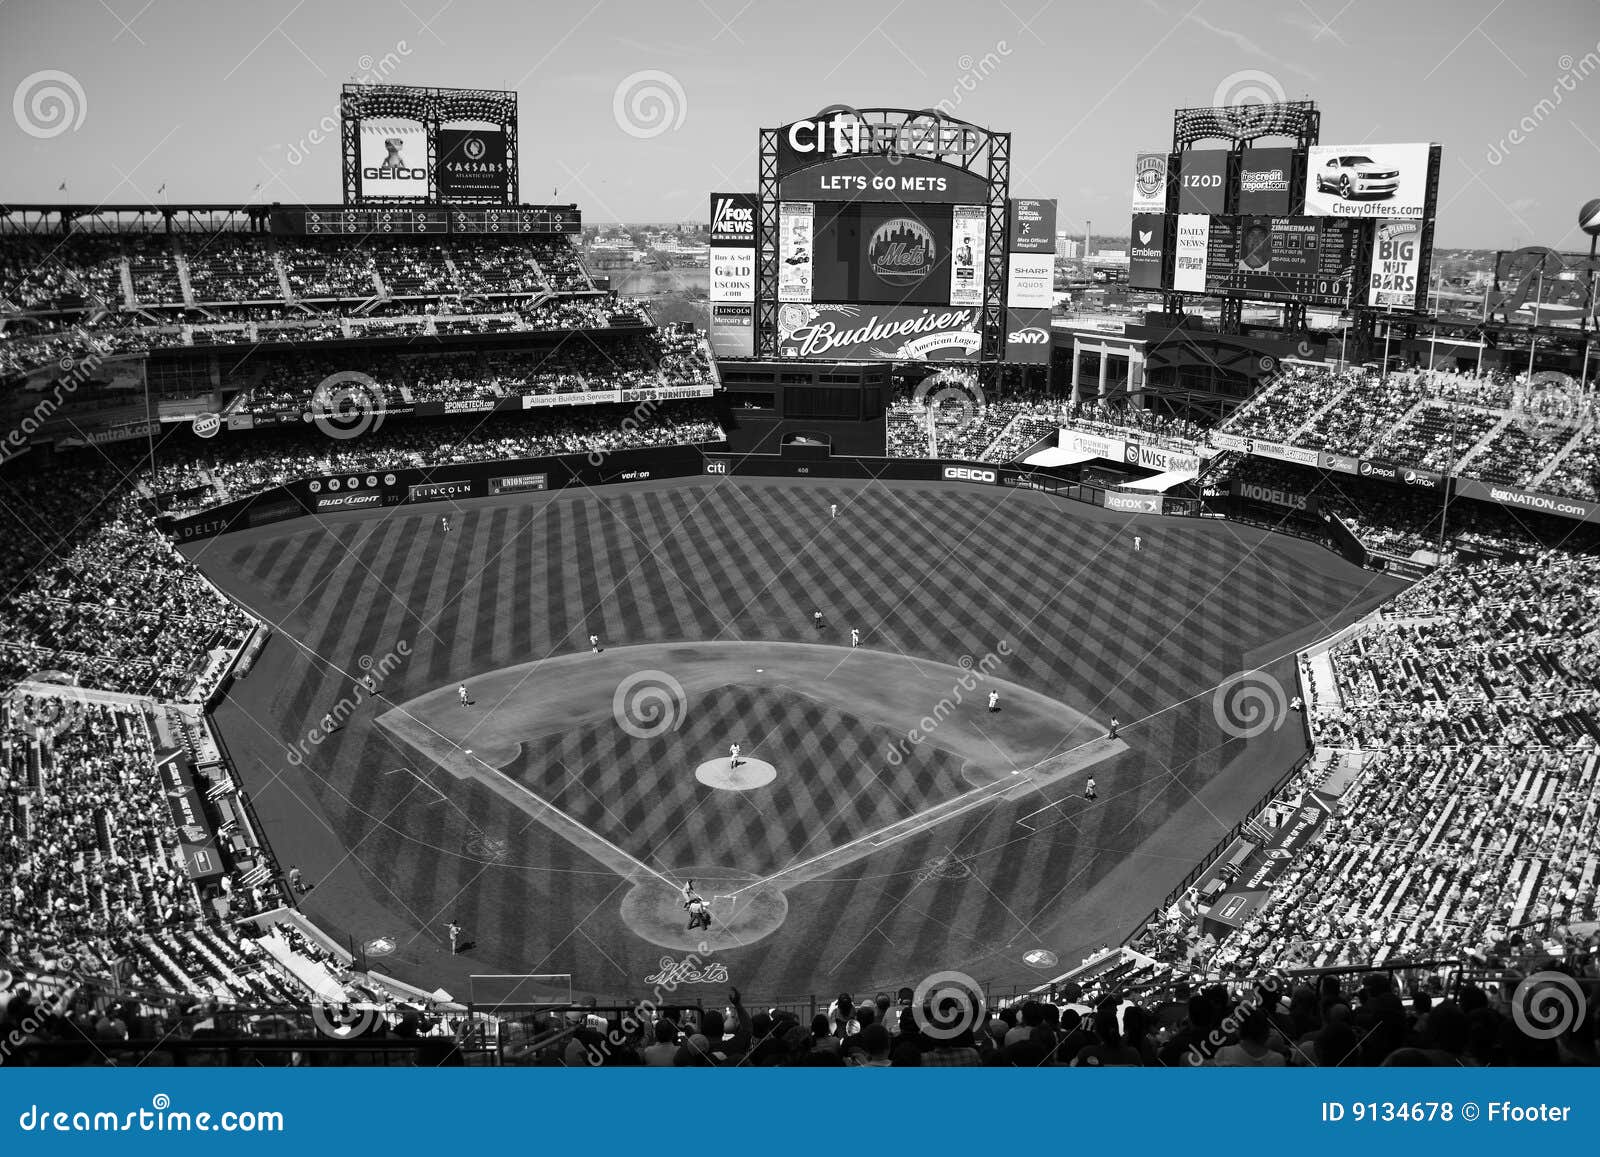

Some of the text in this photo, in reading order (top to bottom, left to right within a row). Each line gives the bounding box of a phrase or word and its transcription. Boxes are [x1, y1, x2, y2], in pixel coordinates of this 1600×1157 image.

[788, 113, 860, 157] citi
[363, 168, 426, 180] GEICO
[446, 163, 503, 172] CAESARS
[821, 176, 946, 191] LET'S GO METS
[1184, 175, 1222, 187] IZOD
[726, 208, 753, 220] FOX
[1332, 203, 1423, 217] ChevyOffers.com
[718, 221, 753, 233] NEWS
[1180, 228, 1206, 236] DAILY
[1389, 224, 1417, 234] PLANTERS
[877, 242, 925, 266] Mets
[1132, 248, 1161, 257] Emblem
[1379, 240, 1414, 261] BIG
[1383, 261, 1408, 274] NUT
[1320, 281, 1327, 293] 0
[1333, 282, 1339, 294] 0
[1372, 274, 1414, 291] BARS
[790, 308, 971, 357] Budweiser
[1008, 329, 1046, 344] SNY
[914, 335, 978, 354] American Lager
[530, 392, 615, 405] Alliance Building Services
[623, 389, 701, 402] BOB'S FURNITURE
[444, 400, 494, 409] SPONGETECH.com
[195, 418, 218, 433] Gulf
[87, 423, 161, 442] Amtrak.com
[1083, 446, 1108, 457] DONUTS
[1243, 439, 1254, 453] $5
[1141, 451, 1167, 468] WISE
[707, 462, 725, 473] citi
[1372, 468, 1395, 477] pepsi
[945, 467, 995, 482] GEICO
[503, 477, 522, 486] UNION
[1416, 478, 1434, 487] max
[417, 484, 471, 497] LINCOLN
[1240, 483, 1307, 510] MODELL'S
[318, 495, 380, 507] BUD LIGHT
[1108, 497, 1142, 509] xerox
[184, 519, 228, 537] DELTA
[644, 963, 729, 985] Mets
